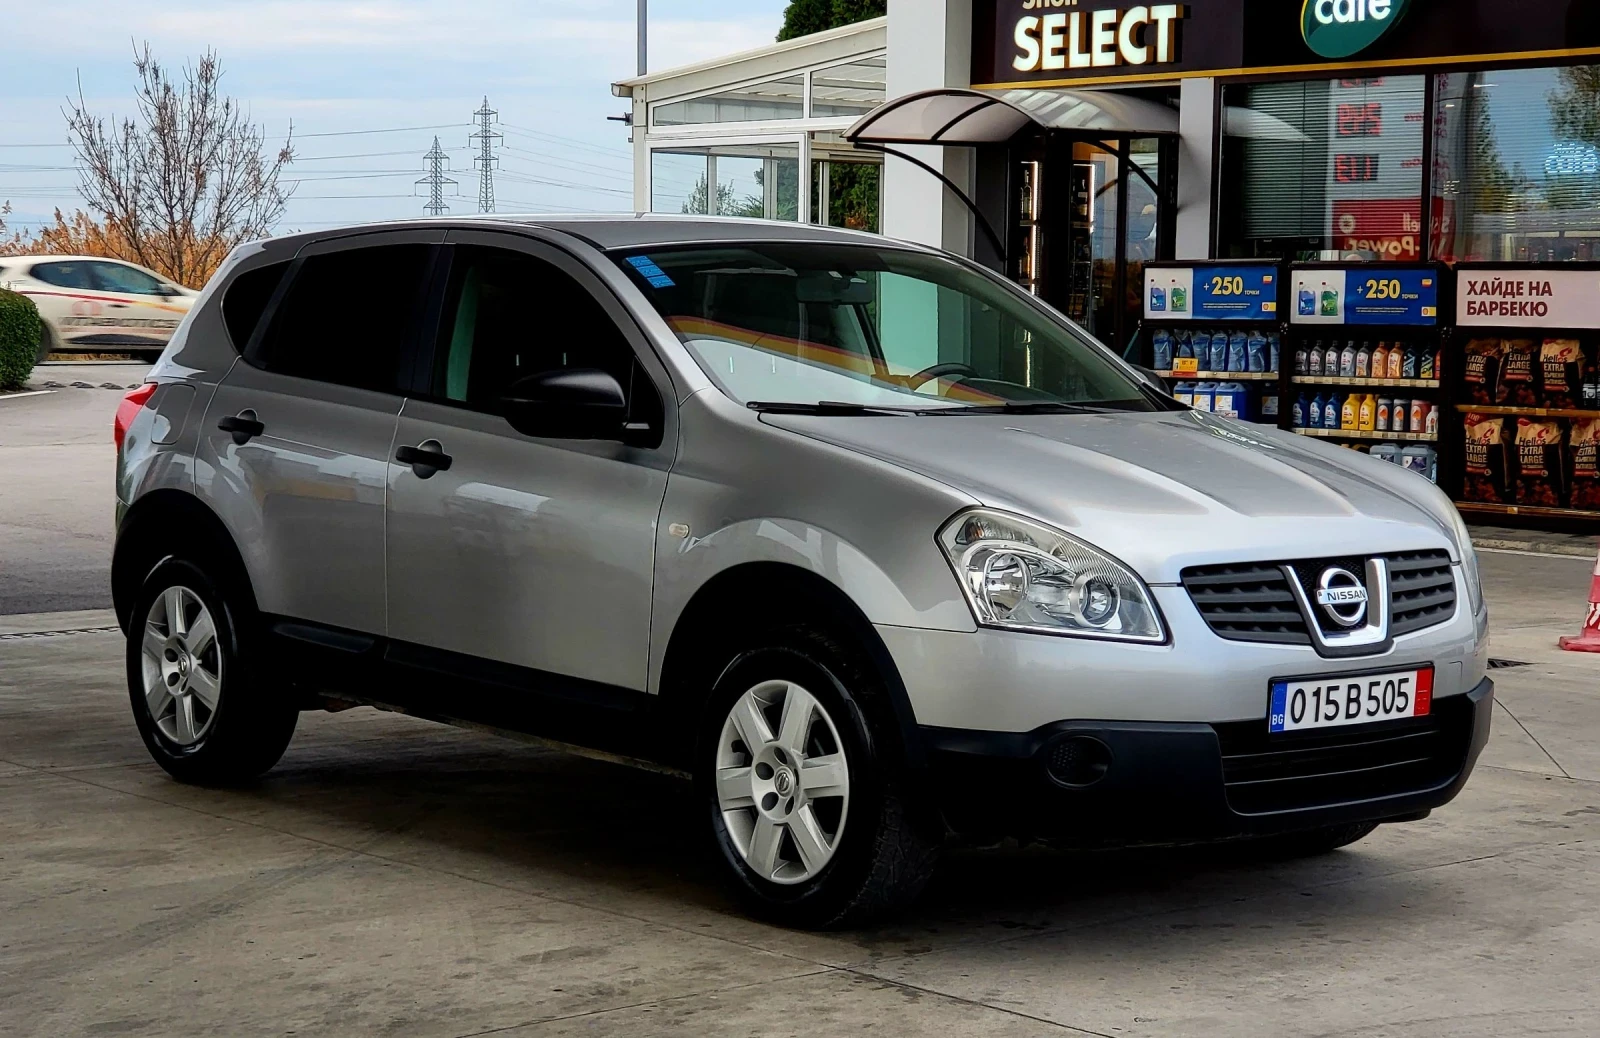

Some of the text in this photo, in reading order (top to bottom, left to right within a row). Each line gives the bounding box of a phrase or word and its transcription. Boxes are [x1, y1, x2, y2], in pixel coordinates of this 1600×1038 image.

[1012, 4, 1177, 72] SELECT
[1466, 277, 1553, 298] ХАЙДЕ НА
[1466, 301, 1548, 317] БАРБЕКЮ
[1507, 361, 1531, 369] LARGE
[1543, 363, 1565, 371] EXTRA
[1465, 444, 1487, 454] EXTRA
[1520, 446, 1543, 455] EXTRA
[1466, 453, 1488, 463] LARGE
[1520, 455, 1544, 464] LARGE
[1327, 590, 1366, 601] NISSAN
[1290, 677, 1410, 724] 015B505
[1271, 713, 1284, 726] BG
